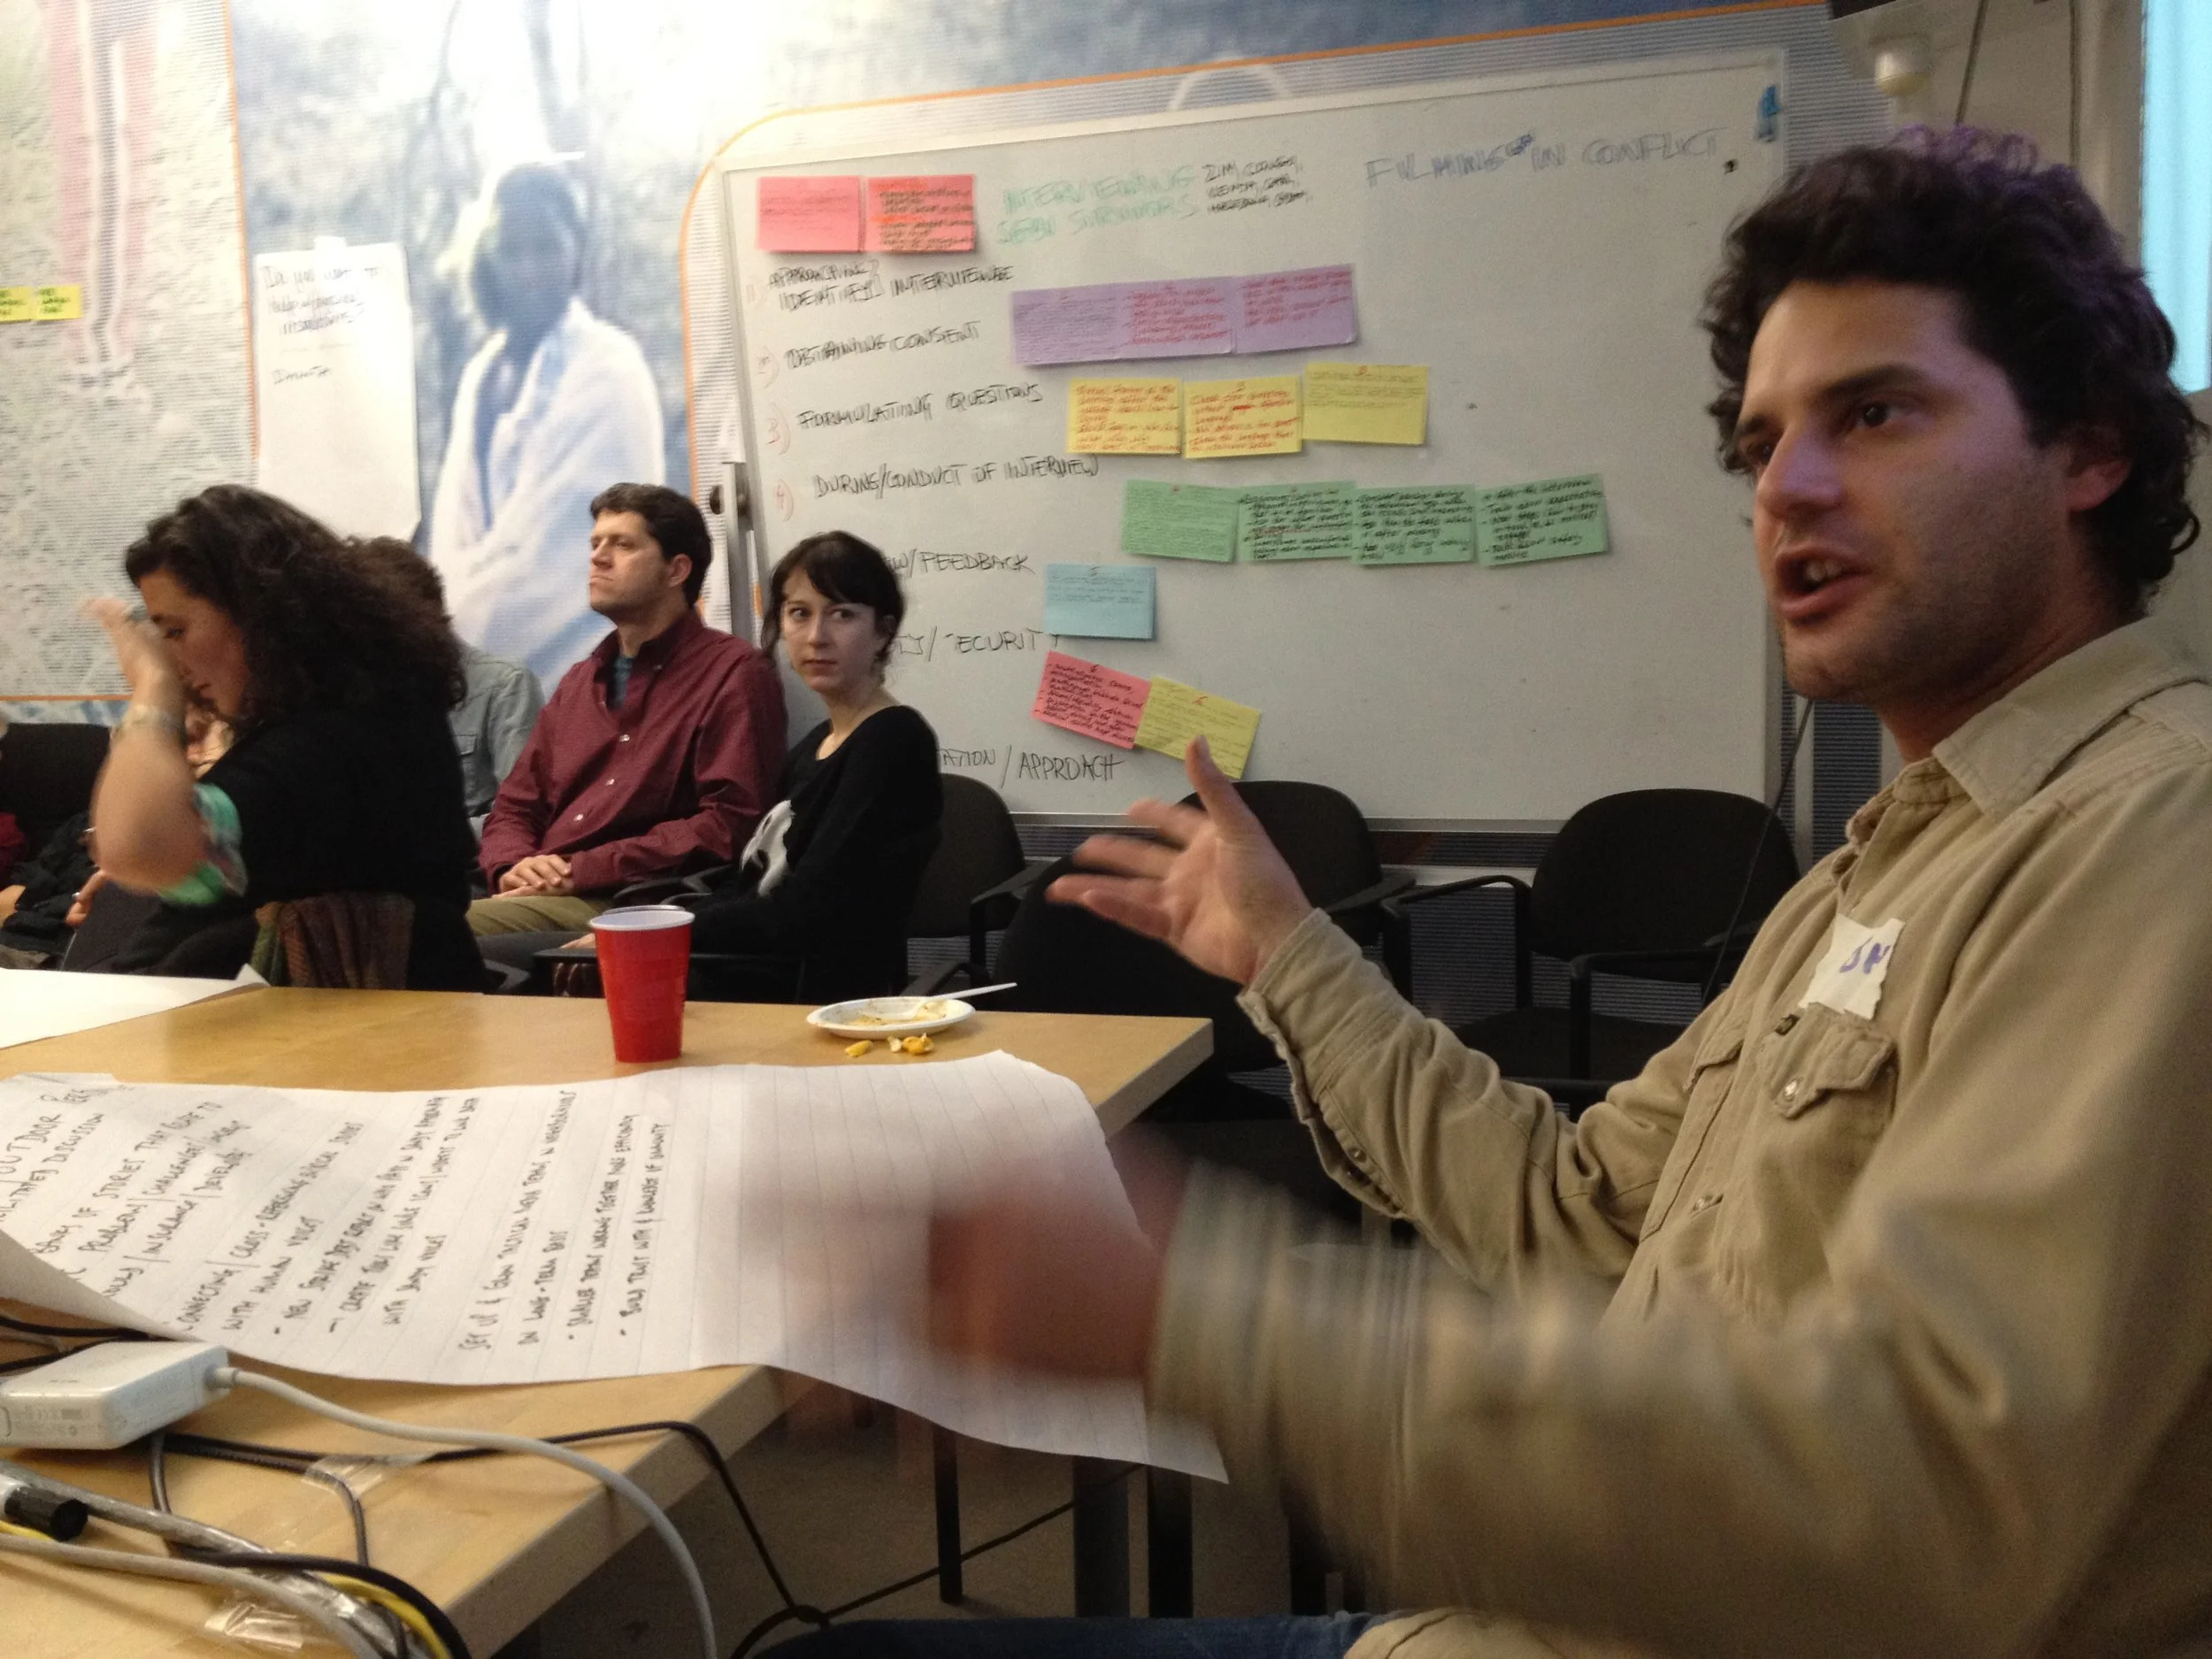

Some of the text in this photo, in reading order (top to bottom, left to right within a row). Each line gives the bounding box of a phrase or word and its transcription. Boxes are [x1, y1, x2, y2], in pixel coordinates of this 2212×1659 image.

[1582, 127, 1727, 165] CONFLICT
[888, 319, 981, 352] CONSENT
[972, 462, 998, 483] OF
